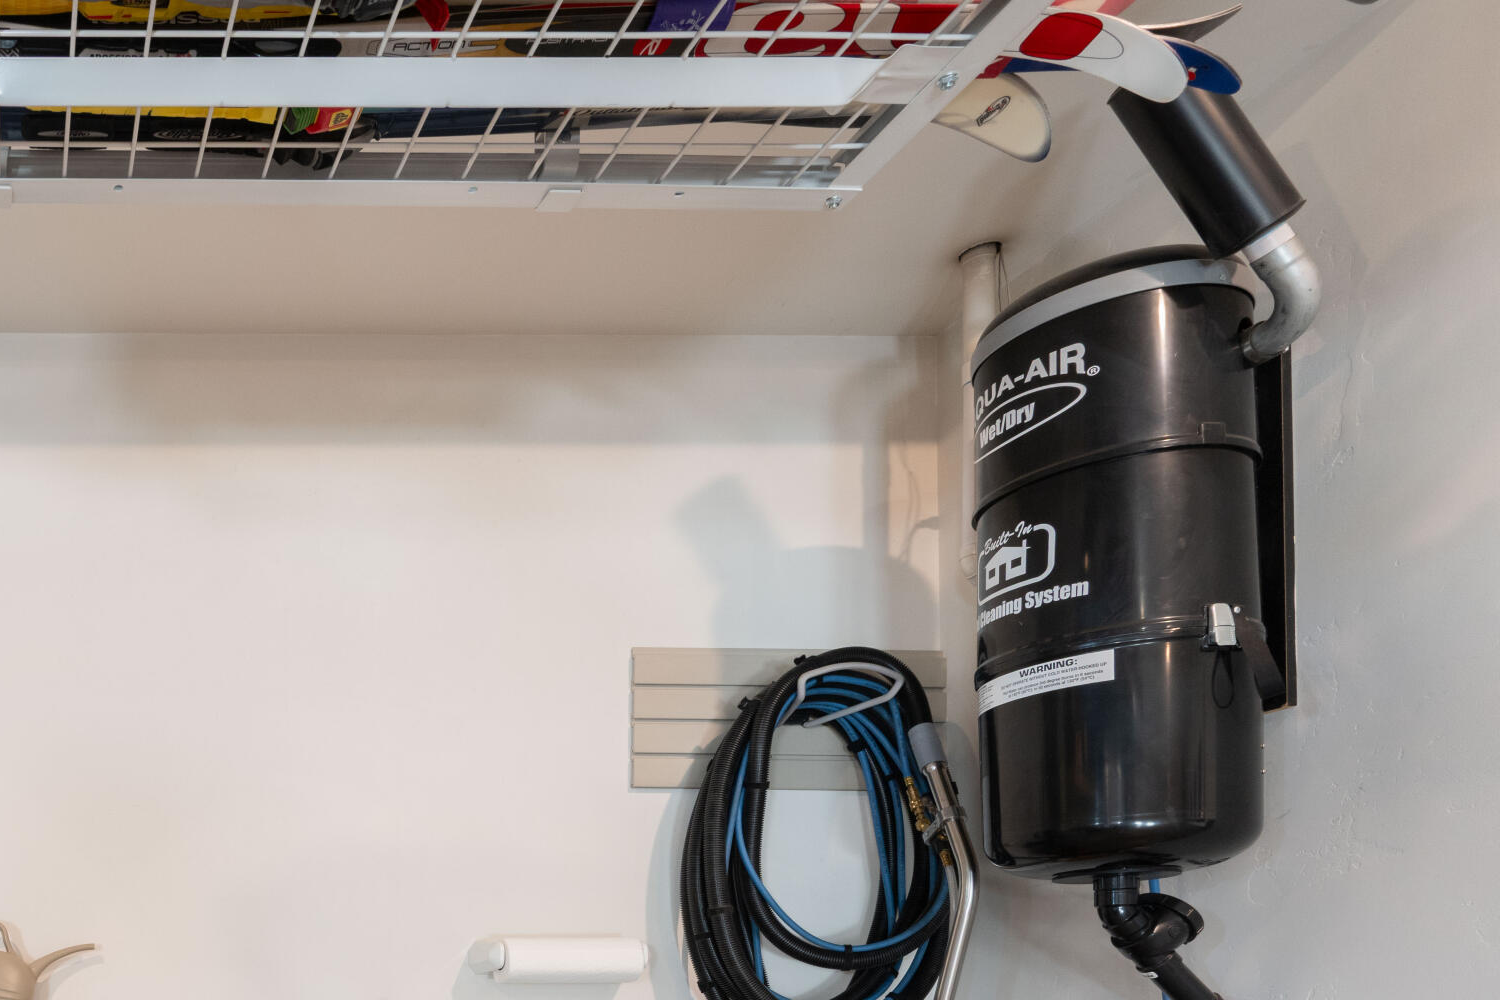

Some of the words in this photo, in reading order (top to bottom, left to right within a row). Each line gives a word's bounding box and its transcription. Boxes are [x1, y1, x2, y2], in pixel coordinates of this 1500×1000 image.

[392, 40, 466, 51] ACTON
[980, 402, 1035, 449] Wet/Dry
[1025, 581, 1089, 609] System
[1020, 659, 1078, 677] WARNING:
